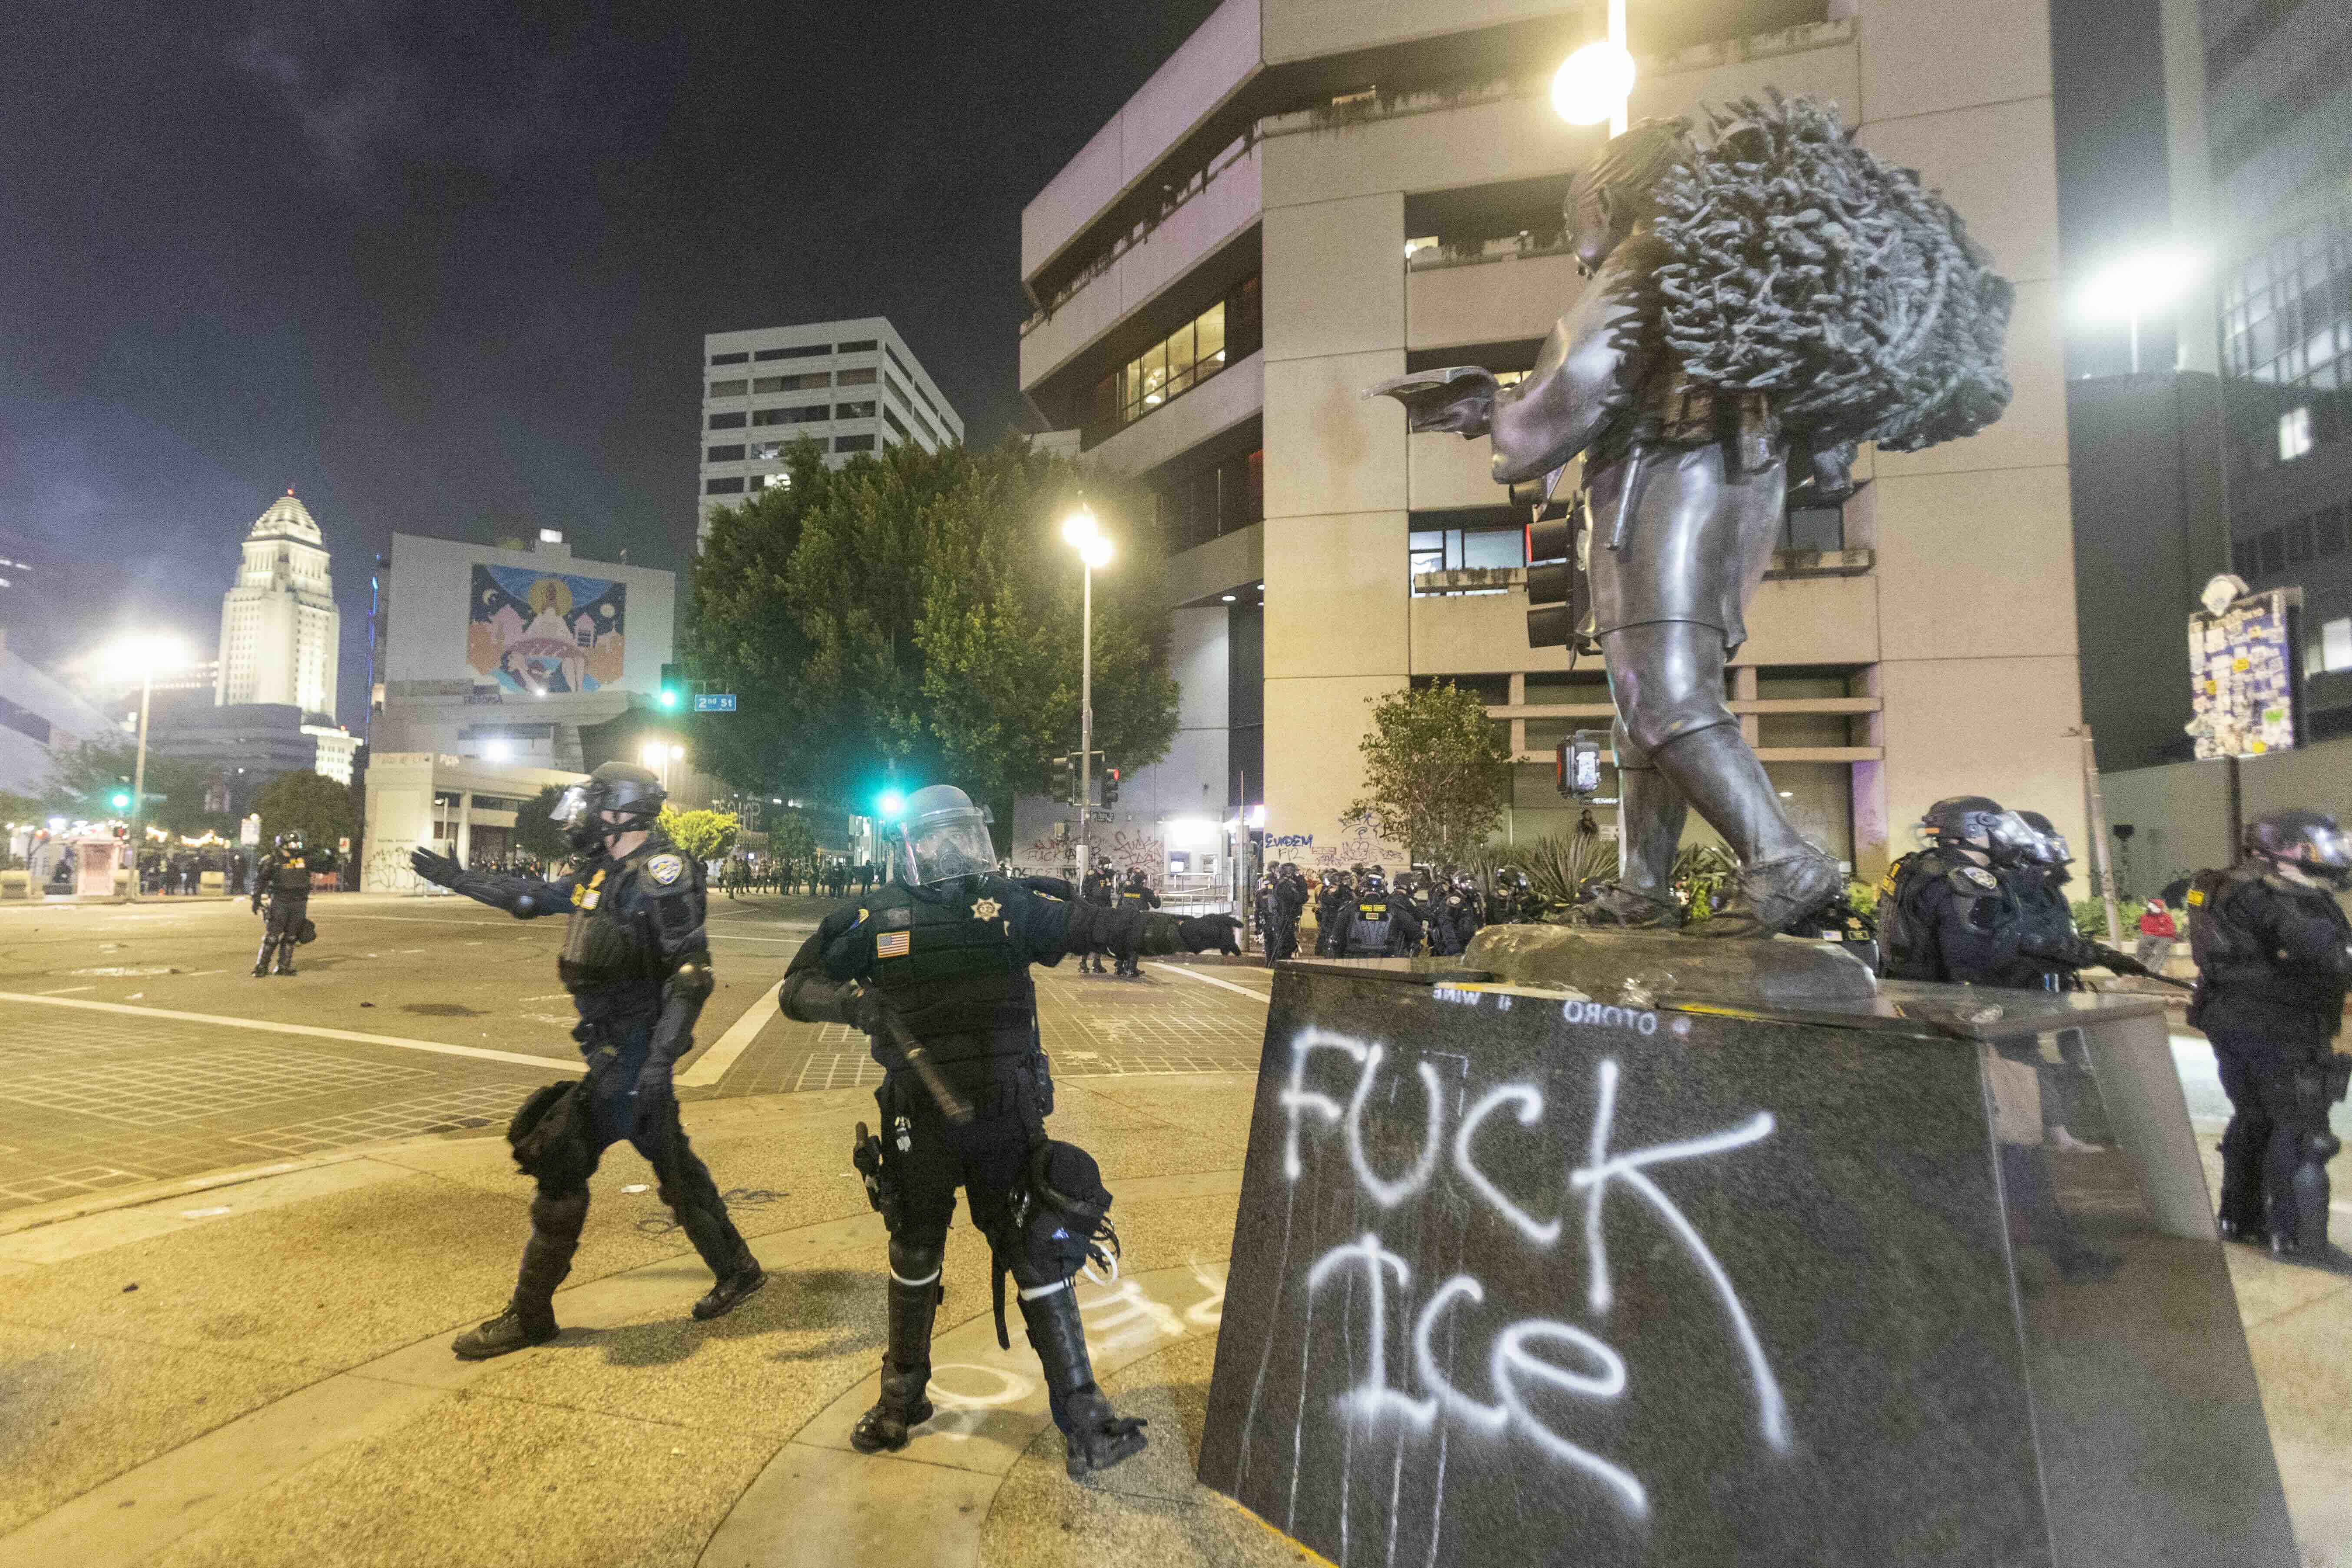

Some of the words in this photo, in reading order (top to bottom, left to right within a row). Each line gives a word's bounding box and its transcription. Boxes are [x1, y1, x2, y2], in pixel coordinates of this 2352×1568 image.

[699, 698, 716, 708] 2nd
[721, 698, 732, 708] St
[1279, 1024, 1795, 1455] FUCK
